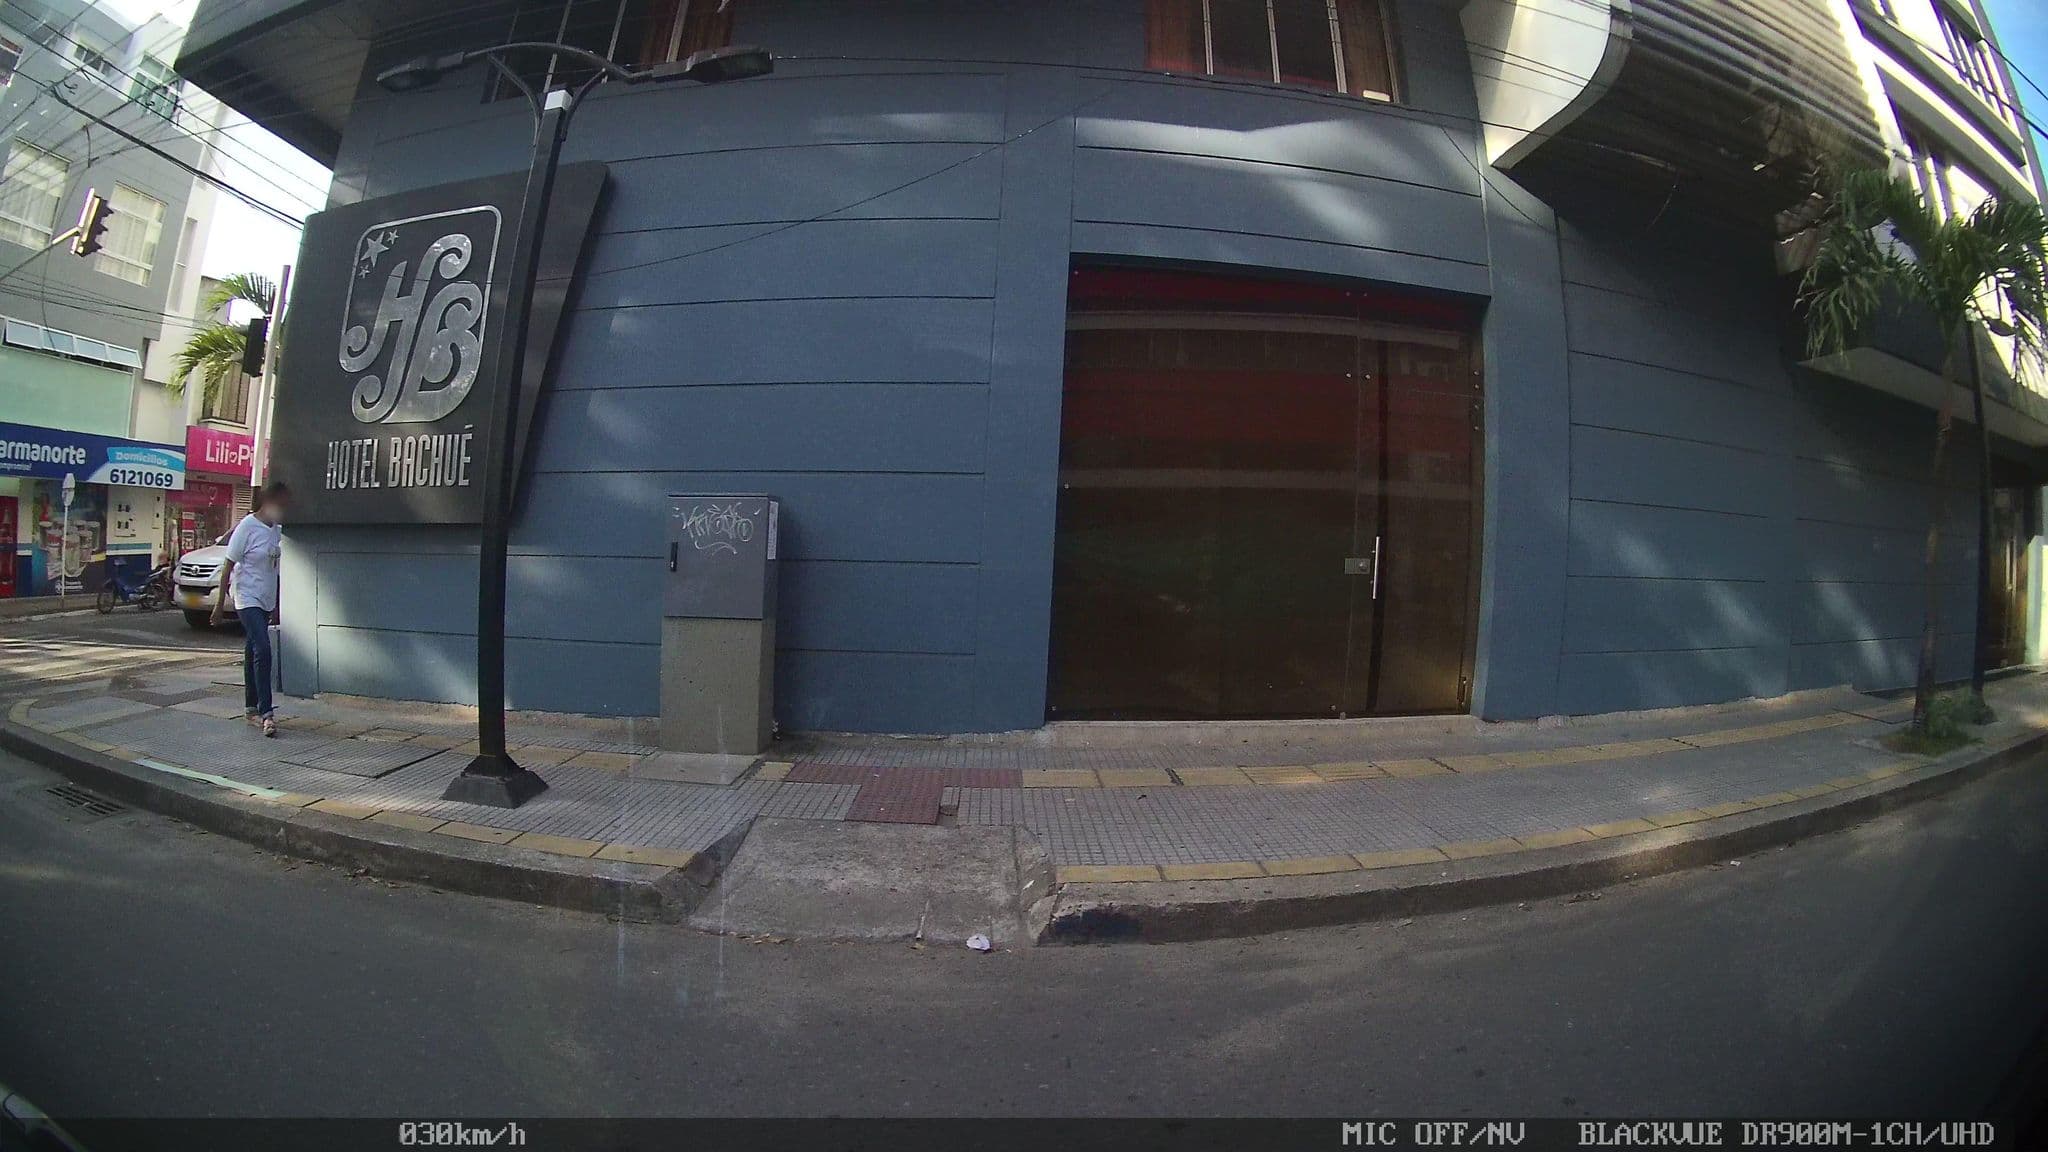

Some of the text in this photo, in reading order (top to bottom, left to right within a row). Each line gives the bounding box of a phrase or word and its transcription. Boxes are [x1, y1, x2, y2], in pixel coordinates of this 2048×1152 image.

[109, 468, 174, 487] 6121069
[325, 424, 473, 489] HOTEL BACHUÉ
